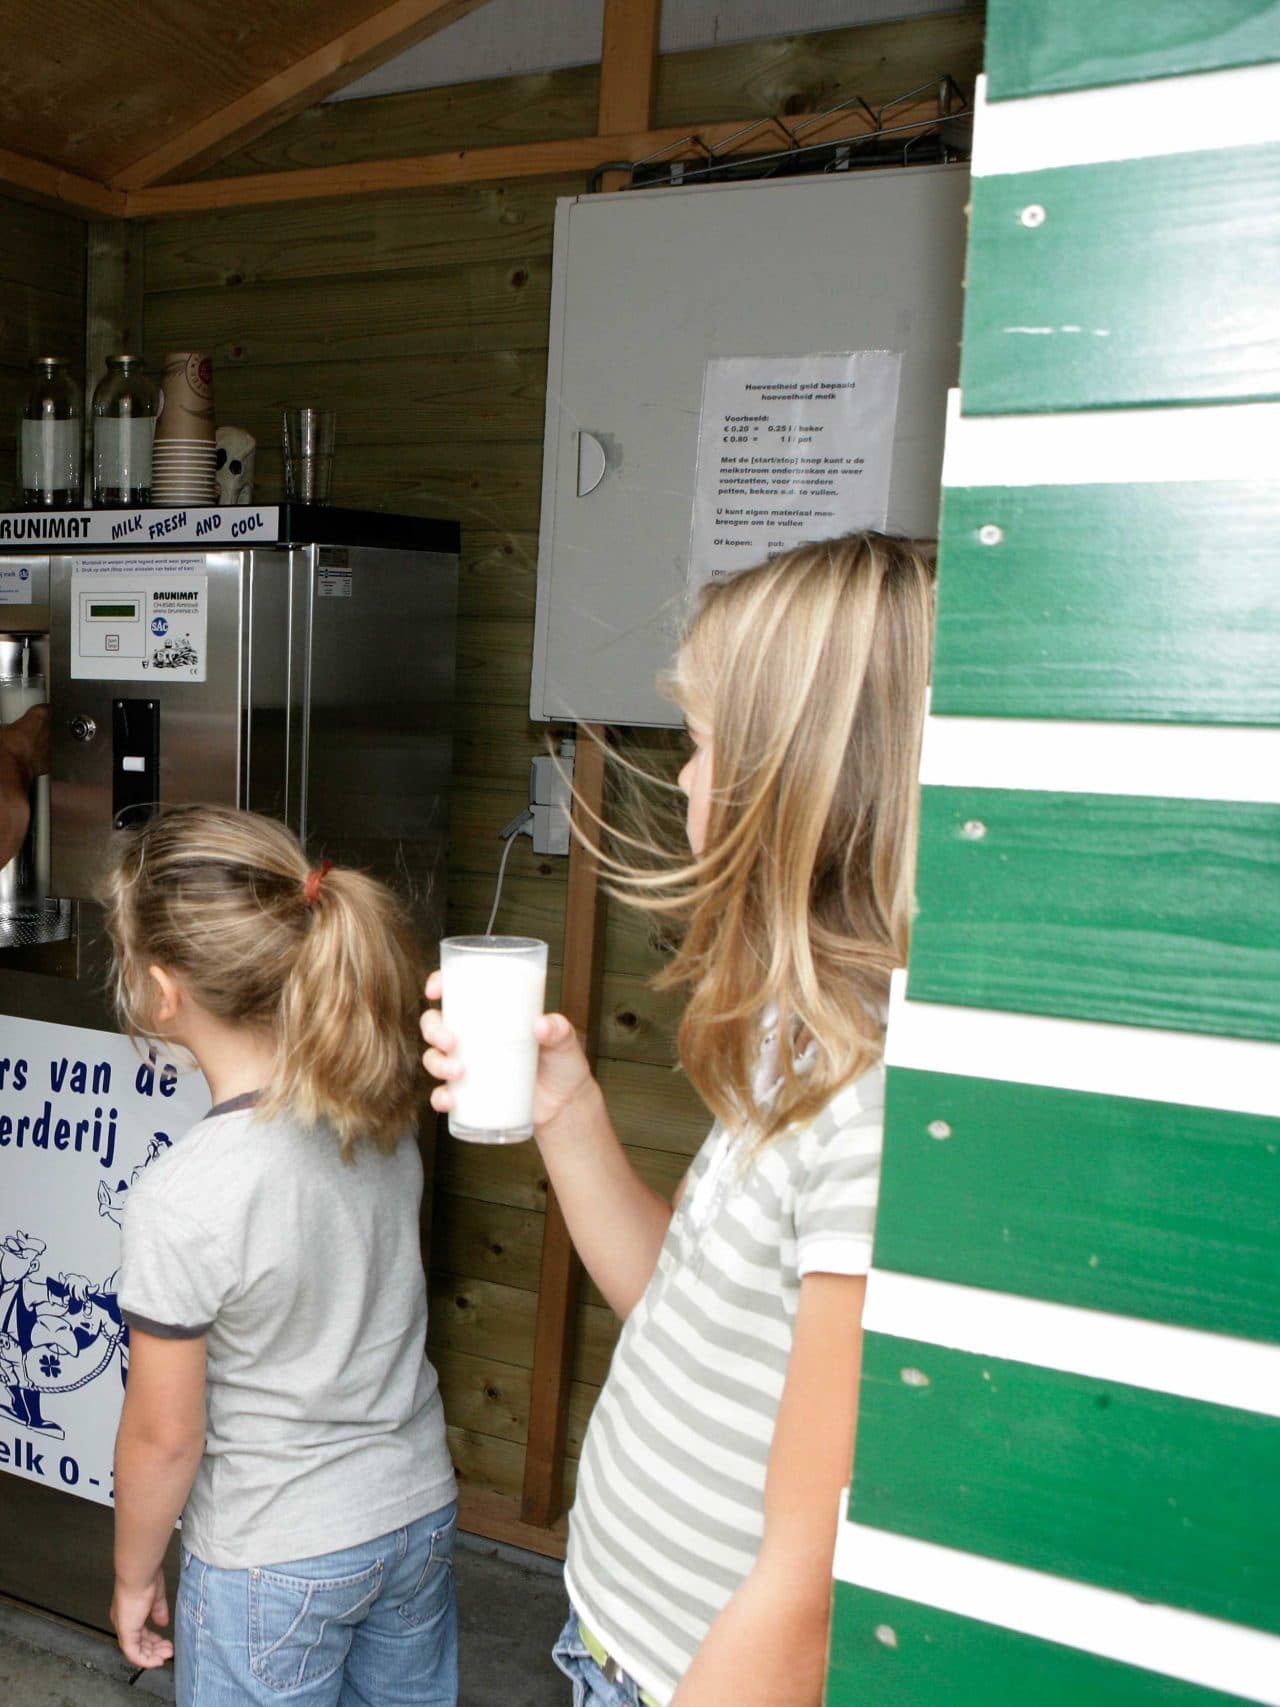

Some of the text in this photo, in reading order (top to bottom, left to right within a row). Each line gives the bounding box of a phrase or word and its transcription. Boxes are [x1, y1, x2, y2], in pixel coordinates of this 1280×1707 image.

[800, 383, 818, 391] geld
[815, 393, 836, 401] melk
[749, 487, 778, 495] bekers
[746, 508, 768, 517] eigen
[111, 514, 143, 540] MILK
[148, 511, 187, 540] FRESH
[196, 514, 221, 536] AND
[231, 512, 263, 537] COOL
[715, 518, 748, 527] brengen
[725, 539, 752, 547] kopen:
[153, 591, 199, 601] BRUNIMAT
[151, 620, 168, 632] SAC
[50, 1057, 111, 1094] van
[135, 1046, 178, 1098] de
[59, 1455, 79, 1486] 0
